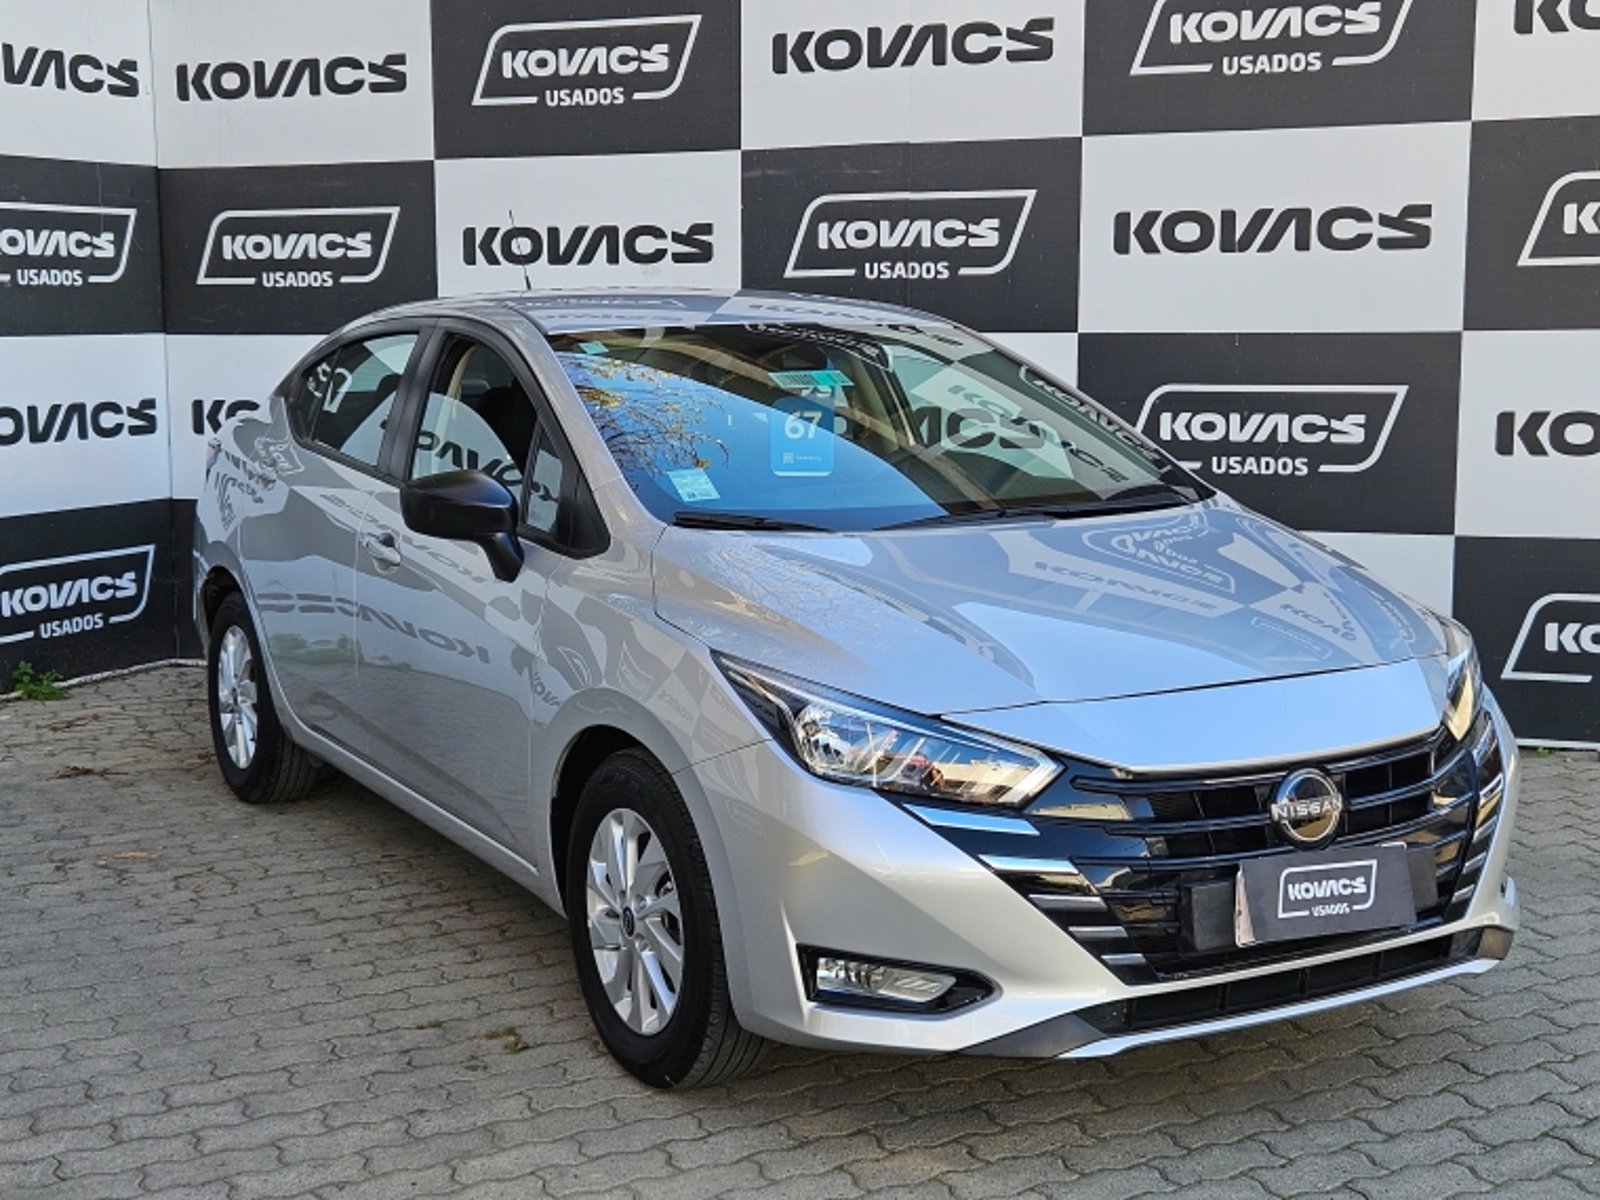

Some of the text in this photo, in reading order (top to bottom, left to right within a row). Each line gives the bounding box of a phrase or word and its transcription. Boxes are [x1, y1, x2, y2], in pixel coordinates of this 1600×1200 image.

[1169, 2, 1382, 43] KOVACS
[772, 17, 1055, 75] KOVACS
[1, 43, 140, 97] VACS
[502, 44, 669, 78] KOVACS
[1222, 52, 1323, 76] USADOS
[176, 53, 407, 101] KOVACS
[545, 87, 625, 106] USADOS
[0, 229, 115, 258] OVACS
[462, 222, 714, 266] KOVACS
[817, 218, 1000, 250] KOVACS
[1113, 203, 1433, 256] KOVACS
[222, 232, 372, 260] KOVACS
[17, 269, 83, 287] USADOS
[262, 271, 334, 288] USADOS
[864, 261, 950, 280] USADOS
[0, 398, 158, 447] OVACS
[785, 411, 822, 439] 67
[1159, 411, 1367, 444] KOVACS
[1211, 456, 1309, 476] USADOS
[1, 571, 138, 618] KOVACS
[40, 612, 104, 639] USADOS
[1271, 793, 1343, 822] NISSAN
[1287, 876, 1367, 902] KOVACS
[1311, 902, 1351, 917] USADOS
